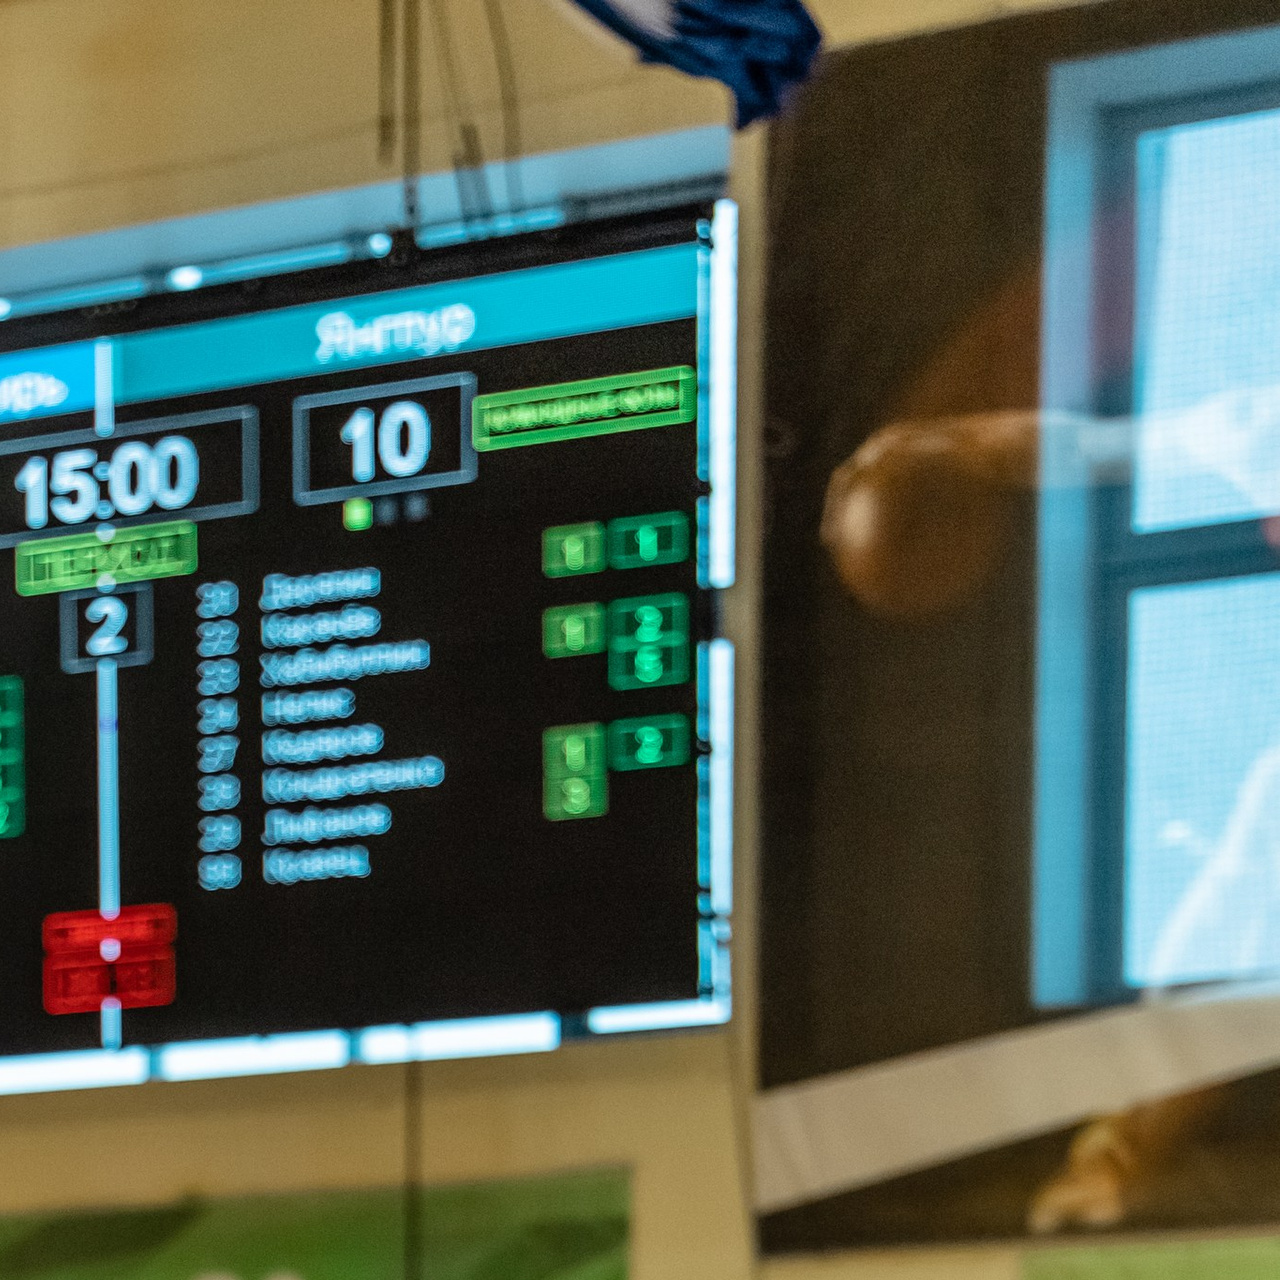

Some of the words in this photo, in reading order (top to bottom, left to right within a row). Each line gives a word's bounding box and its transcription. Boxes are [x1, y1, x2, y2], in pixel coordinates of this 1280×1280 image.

[15, 436, 199, 529] 15:00
[341, 401, 431, 483] 10
[86, 596, 128, 656] 2
